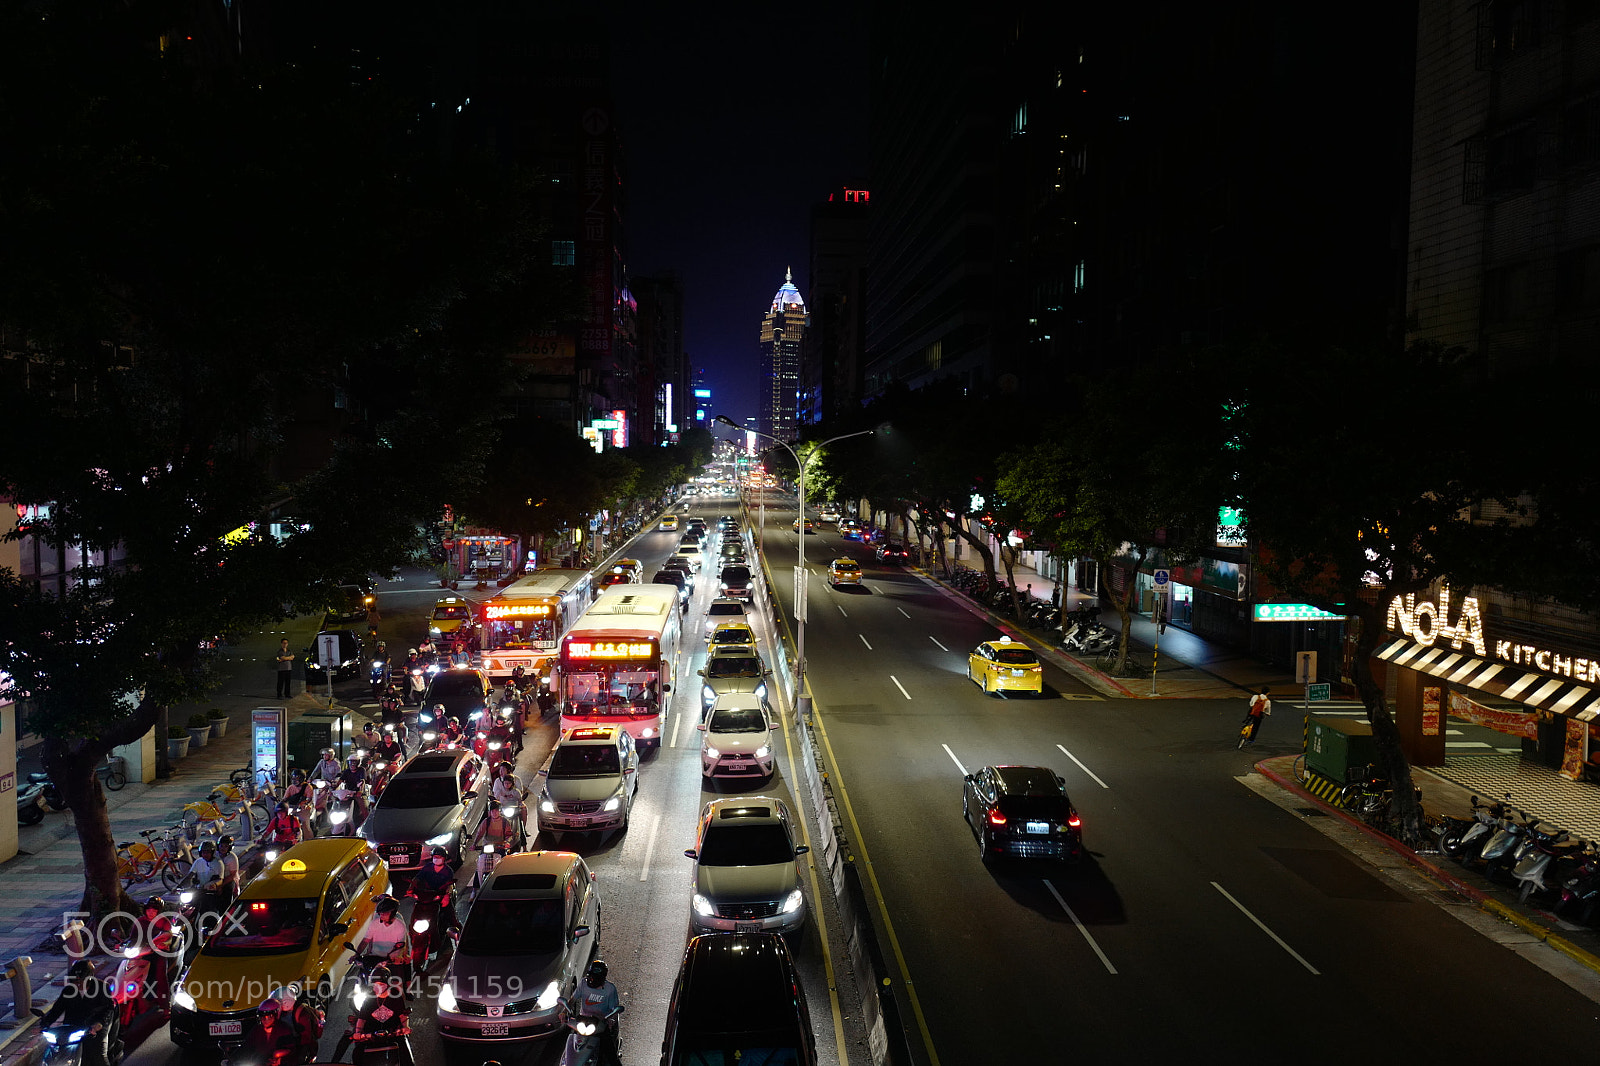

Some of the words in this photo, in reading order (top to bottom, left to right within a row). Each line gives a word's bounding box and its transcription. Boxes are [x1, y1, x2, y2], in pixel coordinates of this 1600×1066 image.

[583, 140, 607, 242] 信義之冠
[581, 328, 608, 339] 2753
[1386, 583, 1487, 656] NOLA
[1496, 640, 1600, 683] KITCHEN
[588, 993, 604, 1003] NIKE
